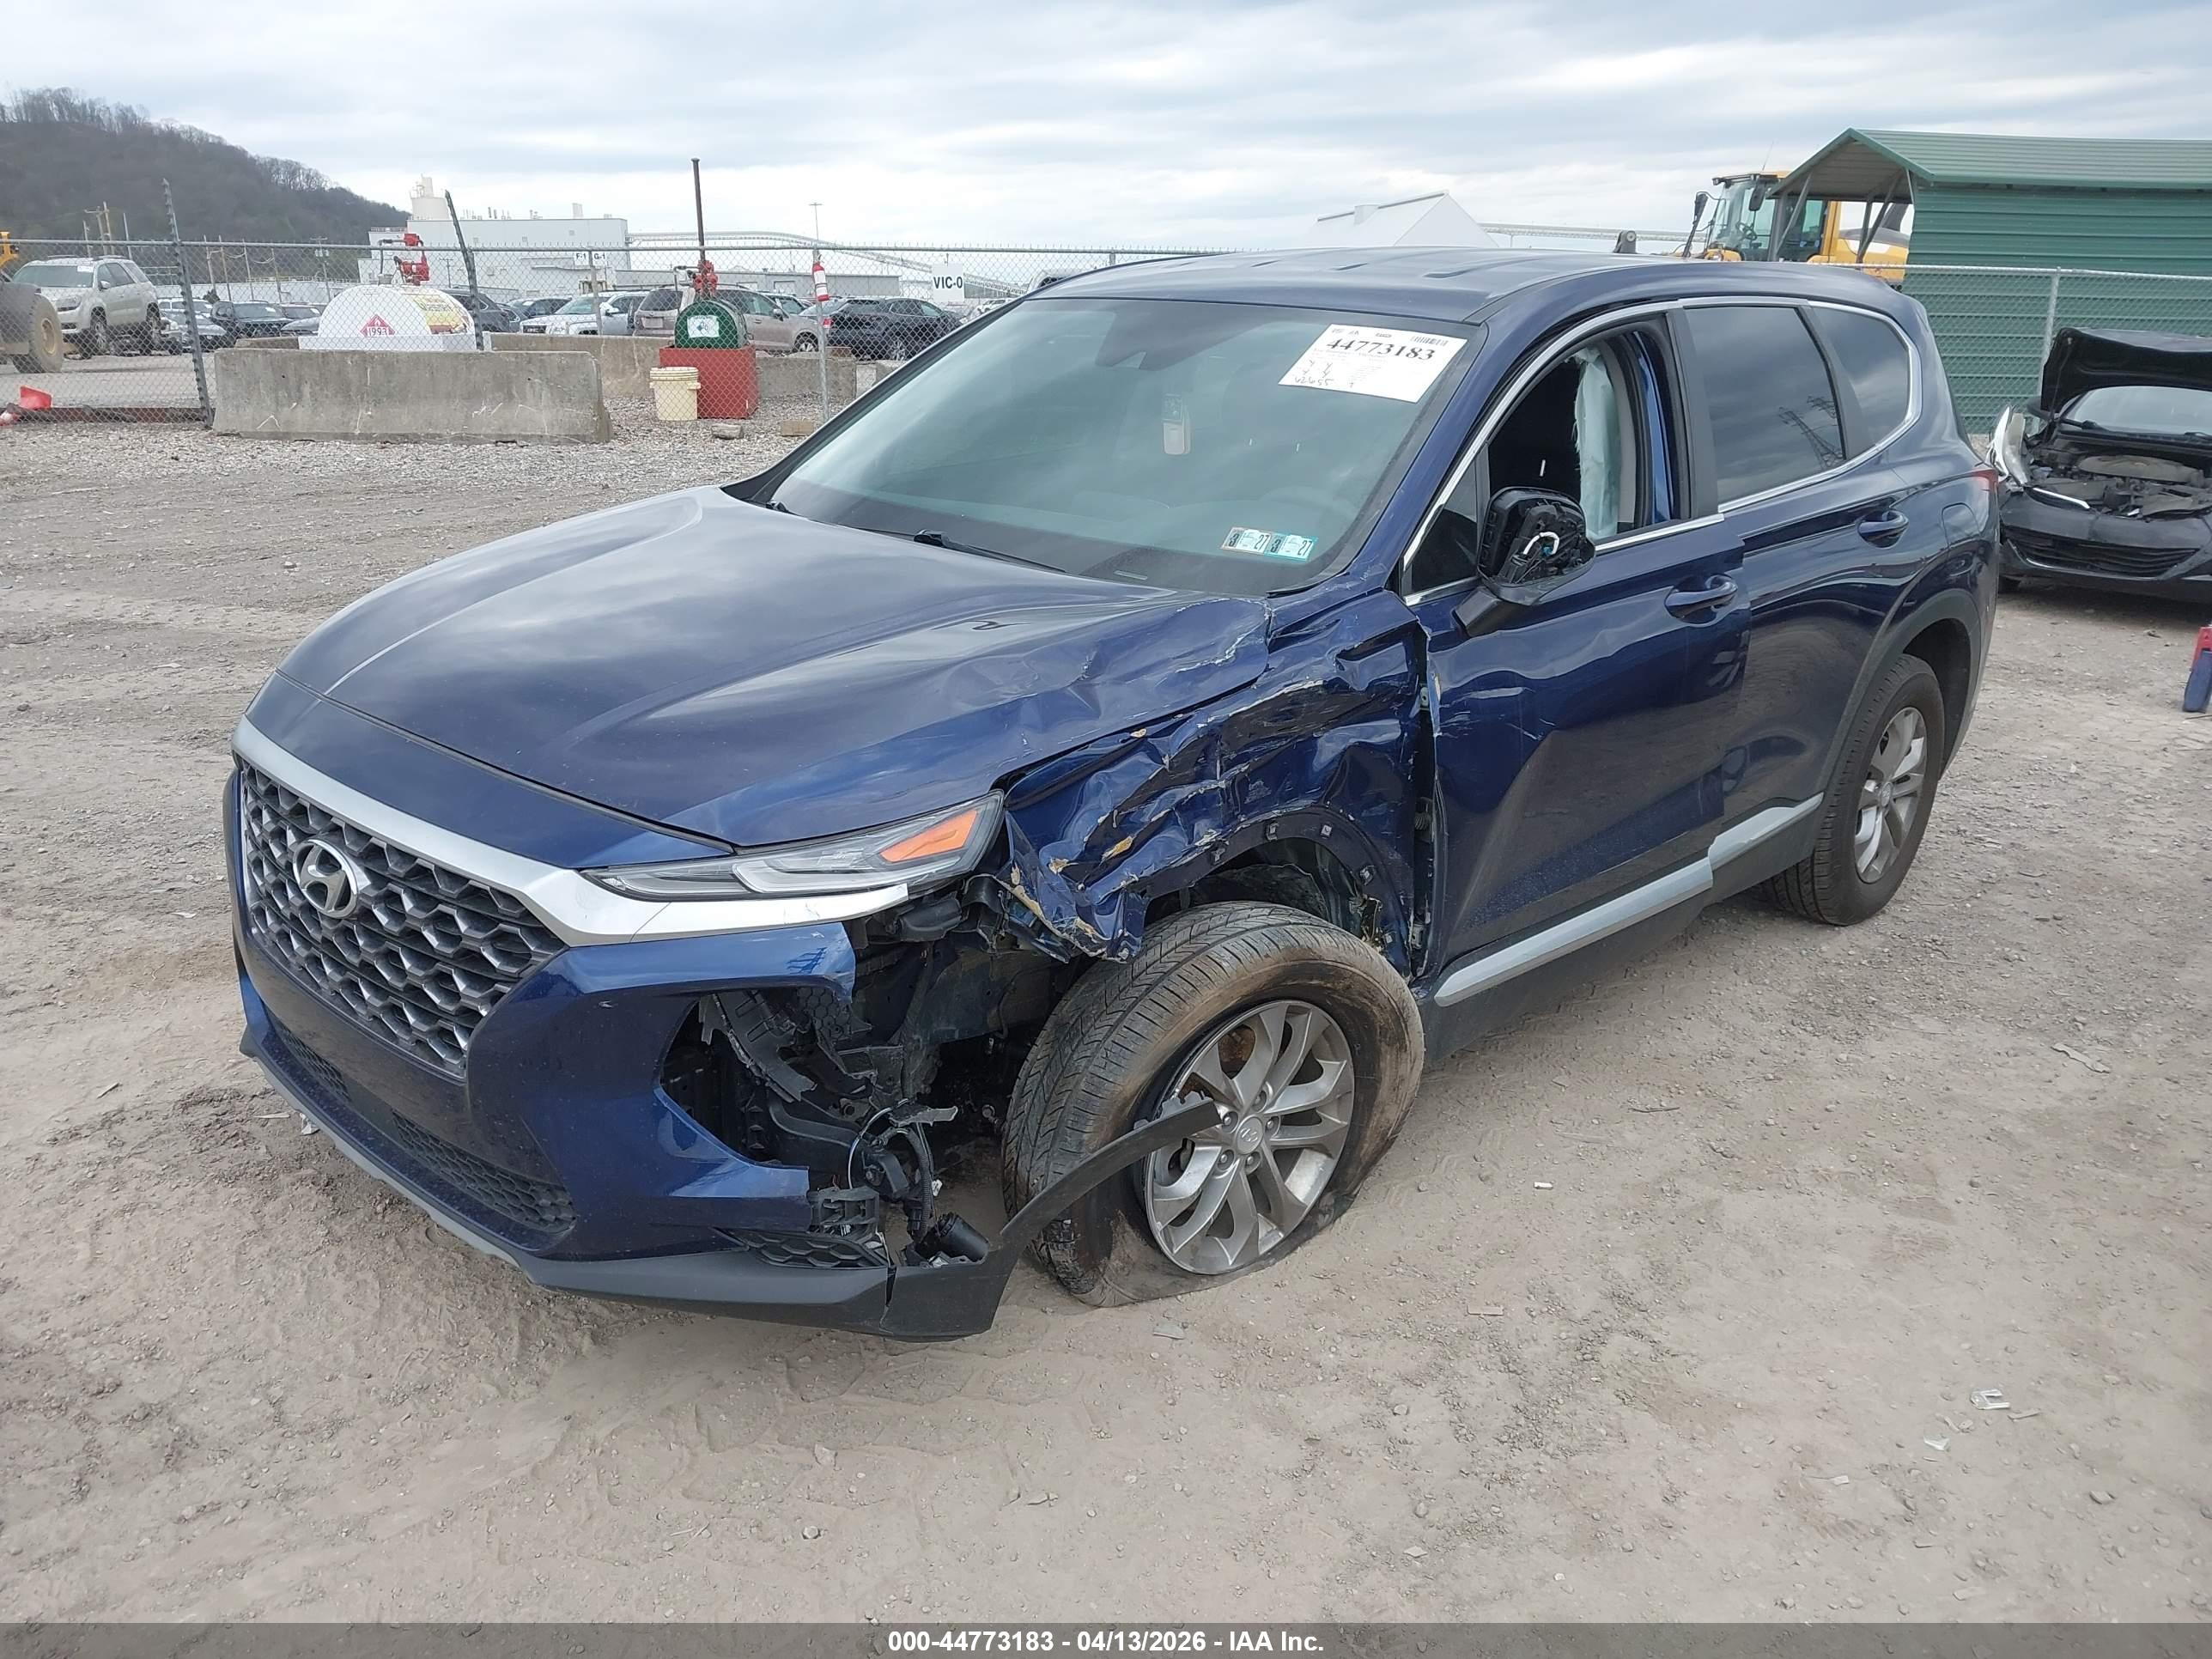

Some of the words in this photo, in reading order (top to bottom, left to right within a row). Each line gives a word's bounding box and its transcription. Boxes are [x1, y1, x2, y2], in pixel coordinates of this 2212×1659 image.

[1326, 337, 1436, 361] 44773183
[1254, 534, 1270, 551] 27
[1297, 539, 1313, 556] 27
